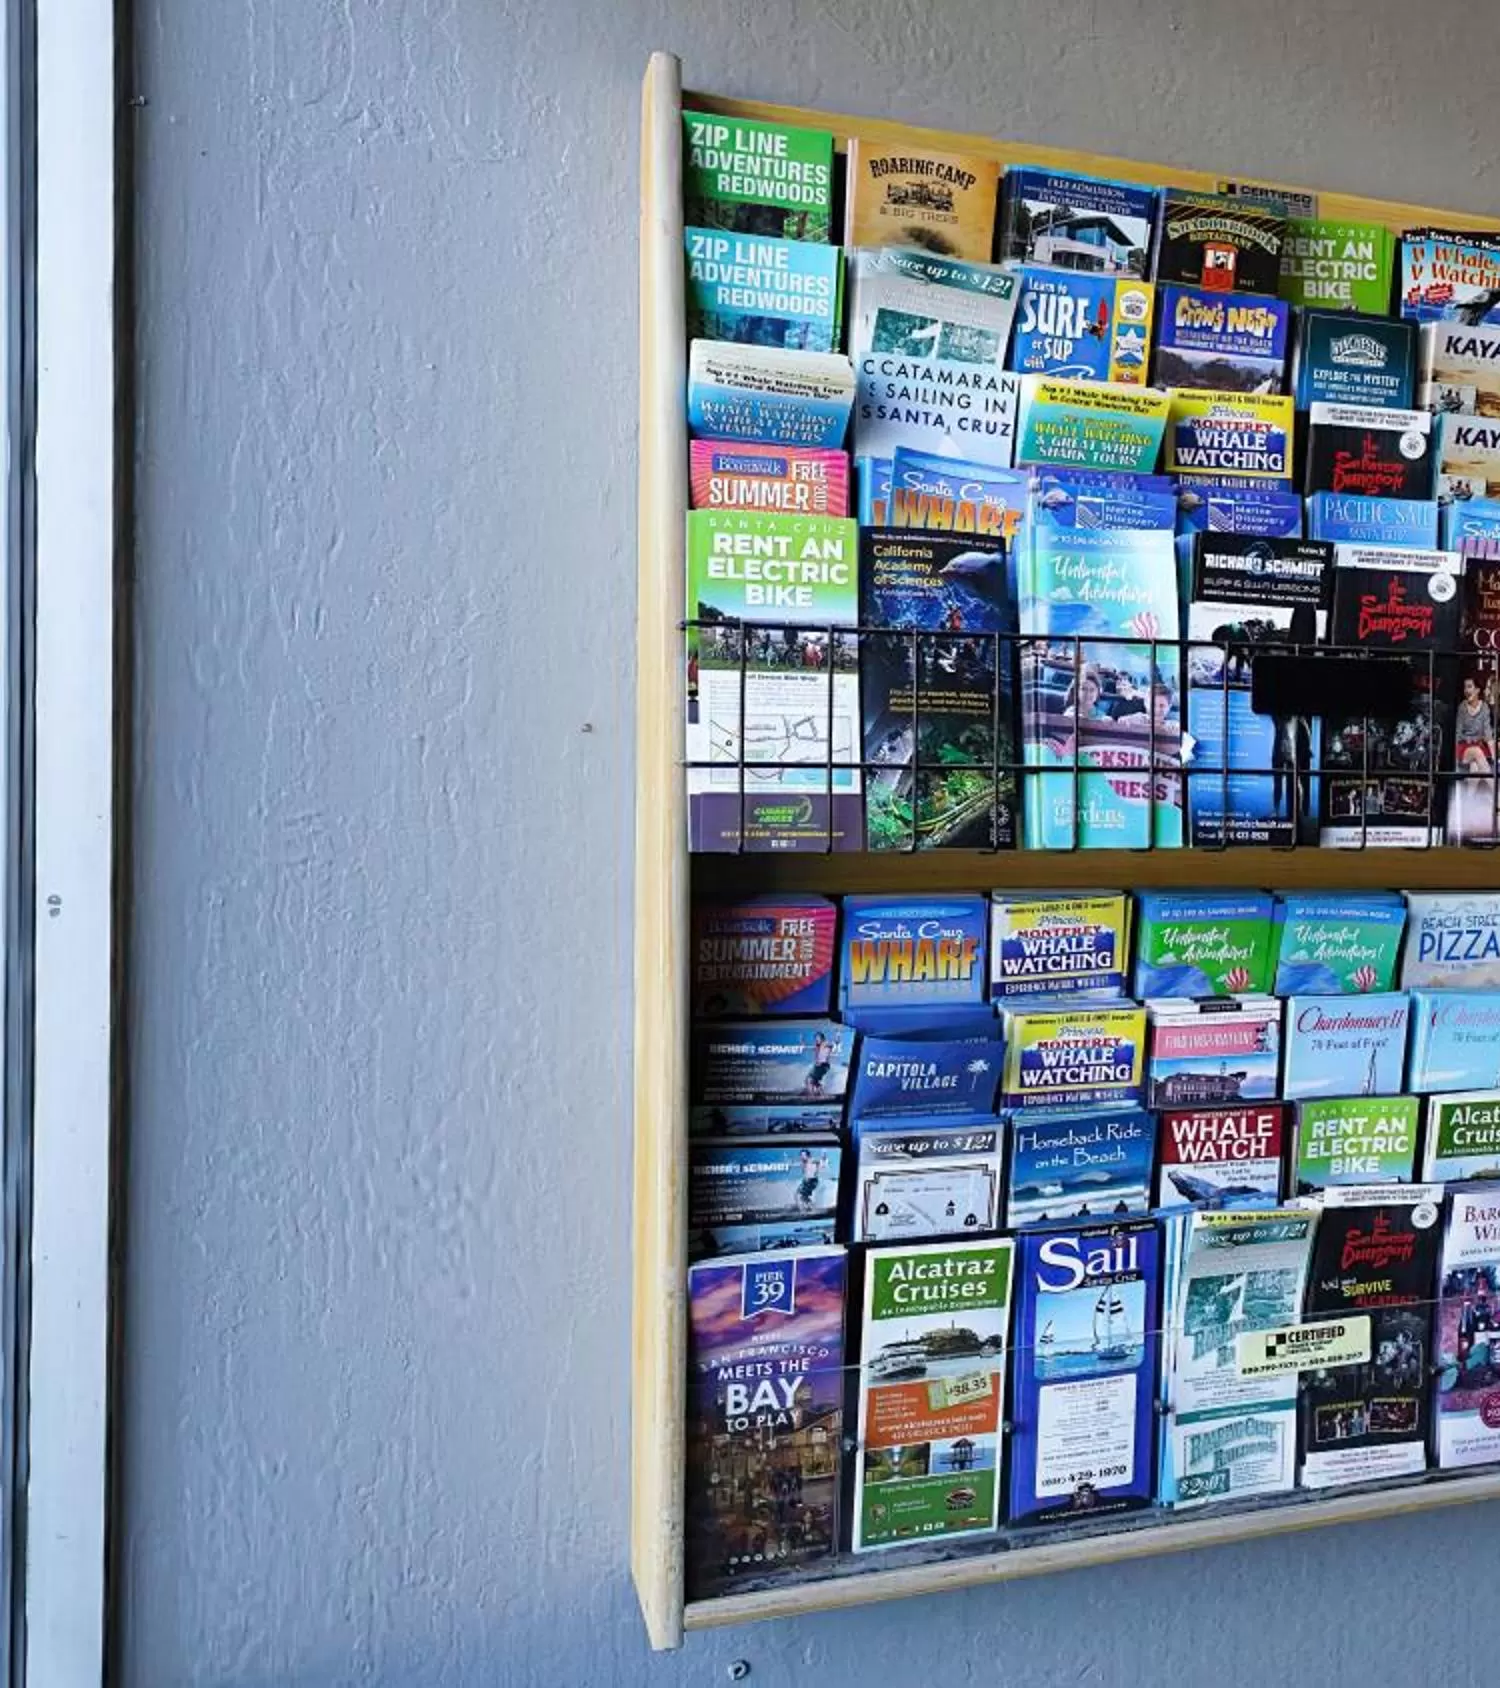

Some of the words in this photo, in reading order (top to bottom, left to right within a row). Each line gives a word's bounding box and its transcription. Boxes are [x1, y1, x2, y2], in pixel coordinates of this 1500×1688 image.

[691, 121, 729, 146] ZIP
[736, 132, 788, 157] LINE
[690, 147, 828, 185] ADVENTURES
[869, 156, 934, 178] ROARING
[935, 160, 977, 191] CAMP
[717, 175, 827, 205] REDWOODS
[691, 235, 729, 260] ZIP
[735, 246, 788, 270] LINE
[1282, 238, 1337, 260] RENT
[1341, 241, 1373, 260] AN
[1435, 244, 1493, 270] Whale
[690, 260, 829, 298] ADVENTURES
[926, 264, 947, 283] up
[950, 268, 969, 282] to
[971, 274, 1012, 296] $12!
[1280, 261, 1377, 282] ELECTRIC
[1029, 276, 1058, 293] Learn
[1059, 282, 1068, 295] to
[1303, 280, 1352, 299] BIKE
[717, 286, 829, 318] REDWOODS
[1018, 291, 1090, 339] SURF
[1044, 338, 1072, 361] SUP
[881, 360, 1015, 393] CATAMARAN
[1363, 372, 1400, 388] MYSTERY
[887, 383, 971, 410] SAILING
[985, 399, 1006, 414] IN
[877, 406, 945, 428] SANTA
[959, 416, 1012, 437] CRUZ
[1191, 419, 1273, 433] MONTEREY
[1195, 430, 1267, 451] WHALE
[792, 460, 826, 482] FREE
[1176, 447, 1284, 471] WATCHING
[709, 479, 810, 511] SUMMER
[902, 471, 952, 497] Santa
[959, 484, 1008, 513] Cruz
[895, 488, 1025, 552] WHARF
[1325, 499, 1389, 524] PACIFIC
[1398, 502, 1434, 528] SAIL
[709, 518, 777, 531] SANTA
[794, 524, 847, 535] CRUZ
[713, 532, 793, 558] RENT
[800, 537, 843, 560] AN
[873, 545, 933, 560] California
[707, 557, 849, 585] ELECTRIC
[873, 559, 933, 576] Academy
[1204, 553, 1262, 571] RICHARD
[1265, 560, 1325, 577] SCHMIDT
[873, 574, 887, 587] of
[888, 574, 944, 588] Sciences
[745, 585, 813, 607] BIKE
[780, 919, 815, 937] FREE
[859, 922, 914, 941] Santa
[918, 921, 964, 946] Cruz
[1017, 924, 1102, 940] MONTEREY
[1421, 916, 1462, 930] BEACH
[700, 938, 798, 963] SUMMER
[1022, 936, 1096, 957] WHALE
[851, 938, 979, 984] WHARF
[1002, 951, 1112, 976] WATCHING
[1037, 1036, 1122, 1051] MONTEREY
[867, 1061, 937, 1077] CAPITOLA
[1041, 1048, 1115, 1068] WHALE
[902, 1075, 959, 1091] VILLAGE
[1022, 1064, 1132, 1087] WATCHING
[1019, 1130, 1103, 1153] Horseback
[1106, 1123, 1142, 1140] Ride
[1172, 1115, 1274, 1143] WHALE
[1312, 1117, 1368, 1139] RENT
[1374, 1117, 1406, 1134] AN
[908, 1141, 930, 1153] up
[932, 1140, 950, 1150] to
[953, 1134, 992, 1151] $12!
[1177, 1138, 1266, 1163] WATCH
[1307, 1135, 1409, 1159] ELECTRIC
[1035, 1159, 1049, 1169] on
[1051, 1155, 1069, 1167] the
[1073, 1146, 1126, 1166] Beach
[1330, 1156, 1381, 1175] BIKE
[888, 1258, 996, 1283] Alcatraz
[1036, 1237, 1138, 1293] Sail
[755, 1271, 784, 1284] PIER
[1343, 1279, 1392, 1297] SURVIVE
[753, 1282, 785, 1305] 39
[893, 1279, 987, 1303] Cruises
[1287, 1325, 1345, 1344] CERTIFIED
[738, 1343, 829, 1363] FRANCISCO
[717, 1361, 773, 1382] MEETS
[780, 1358, 810, 1373] THE
[726, 1376, 804, 1416] BAY
[725, 1418, 748, 1434] TO
[756, 1410, 801, 1428] PLAY
